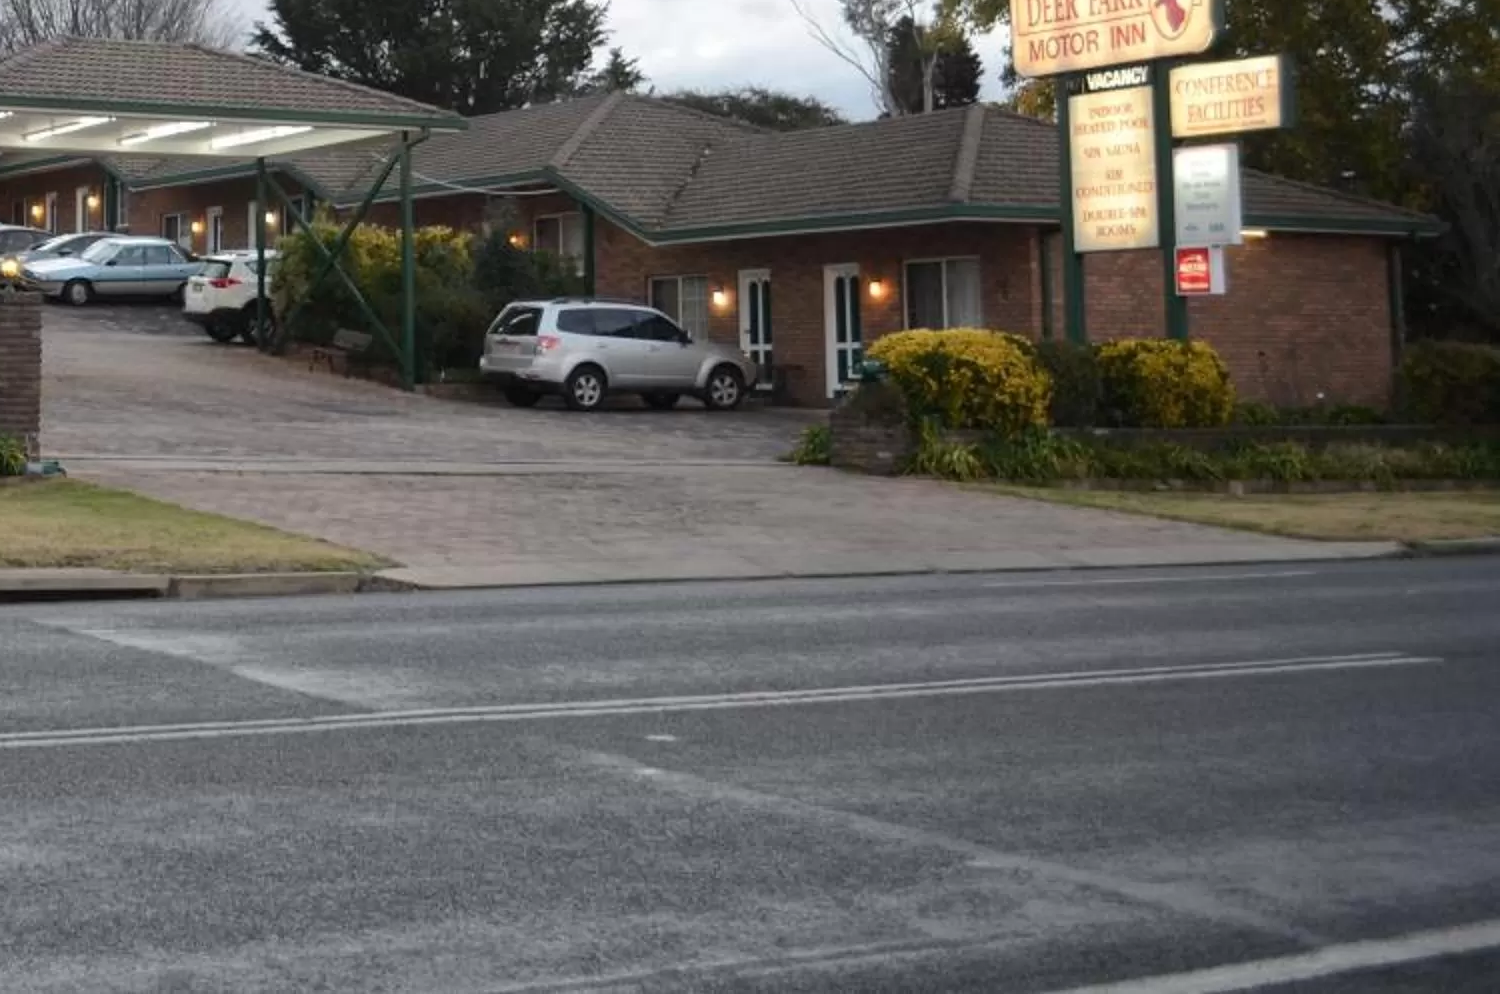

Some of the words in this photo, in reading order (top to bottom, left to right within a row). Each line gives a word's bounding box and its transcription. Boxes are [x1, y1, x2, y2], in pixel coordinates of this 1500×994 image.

[1029, 29, 1100, 62] MOTOR
[1110, 21, 1146, 51] INN
[1086, 65, 1148, 91] VACANCY
[1175, 67, 1274, 95] CONFERENCE
[1187, 95, 1265, 123] FACILITIES
